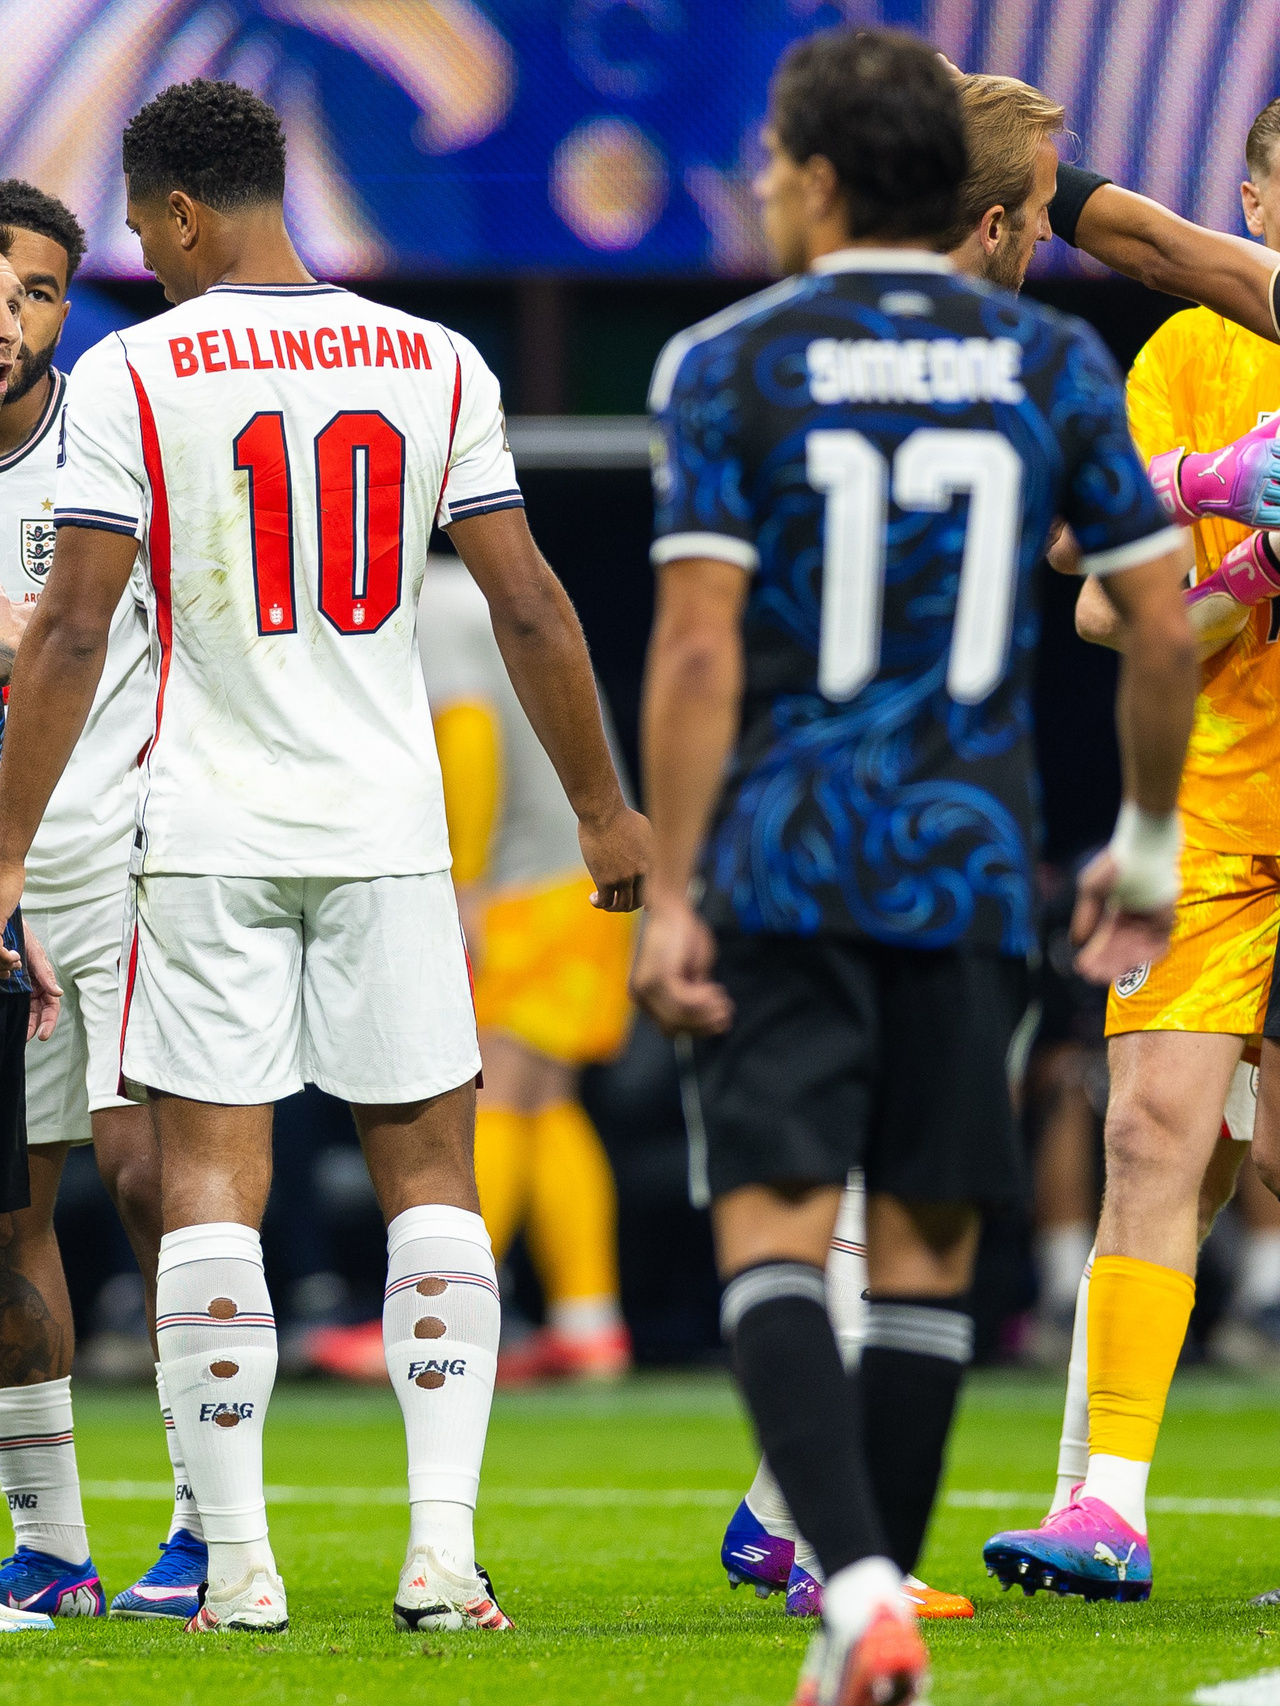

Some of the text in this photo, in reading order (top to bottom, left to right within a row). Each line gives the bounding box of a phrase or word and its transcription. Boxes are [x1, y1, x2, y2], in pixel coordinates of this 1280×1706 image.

[169, 325, 433, 378] BELLINGHAM
[807, 338, 1025, 404] SIMEONE
[232, 410, 406, 636] 10
[806, 428, 1023, 706] 17
[8, 1493, 38, 1511] ENG
[176, 1484, 196, 1501] EN
